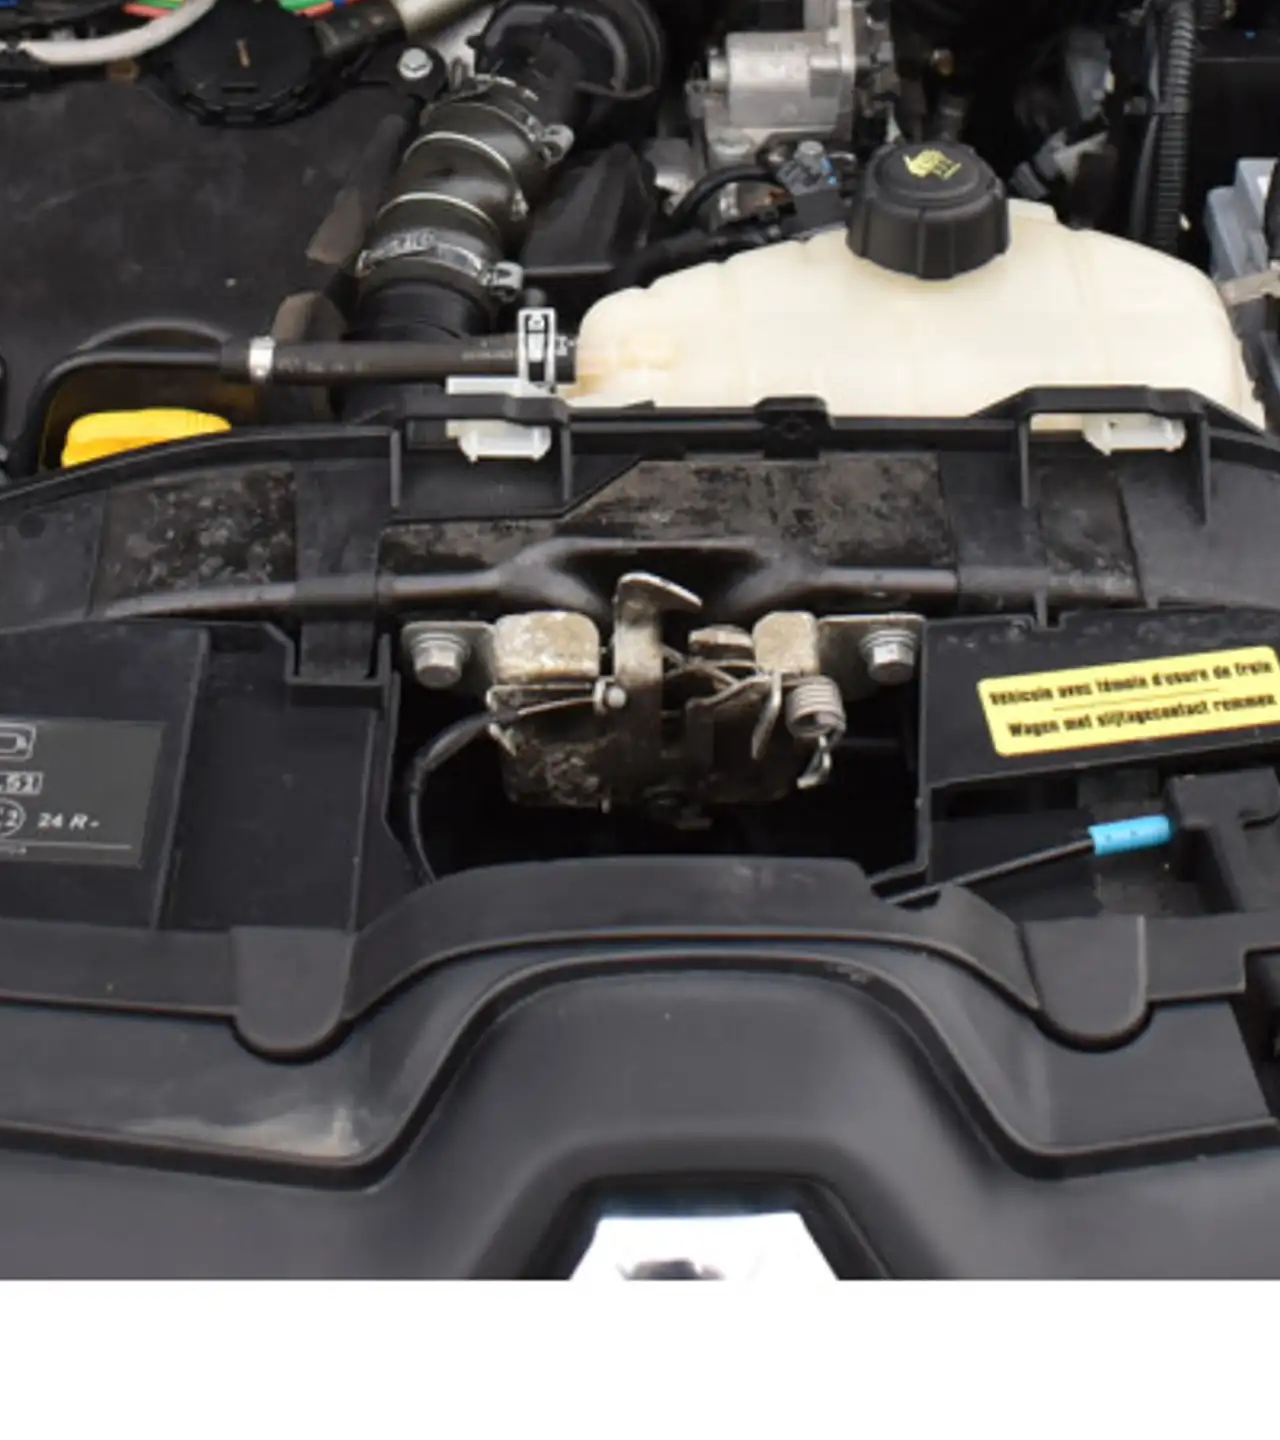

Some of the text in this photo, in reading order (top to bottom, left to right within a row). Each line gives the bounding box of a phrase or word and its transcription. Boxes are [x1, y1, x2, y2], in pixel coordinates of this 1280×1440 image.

[1008, 720, 1059, 736] Wagen
[1063, 714, 1092, 731] met
[1213, 694, 1277, 711] remmen
